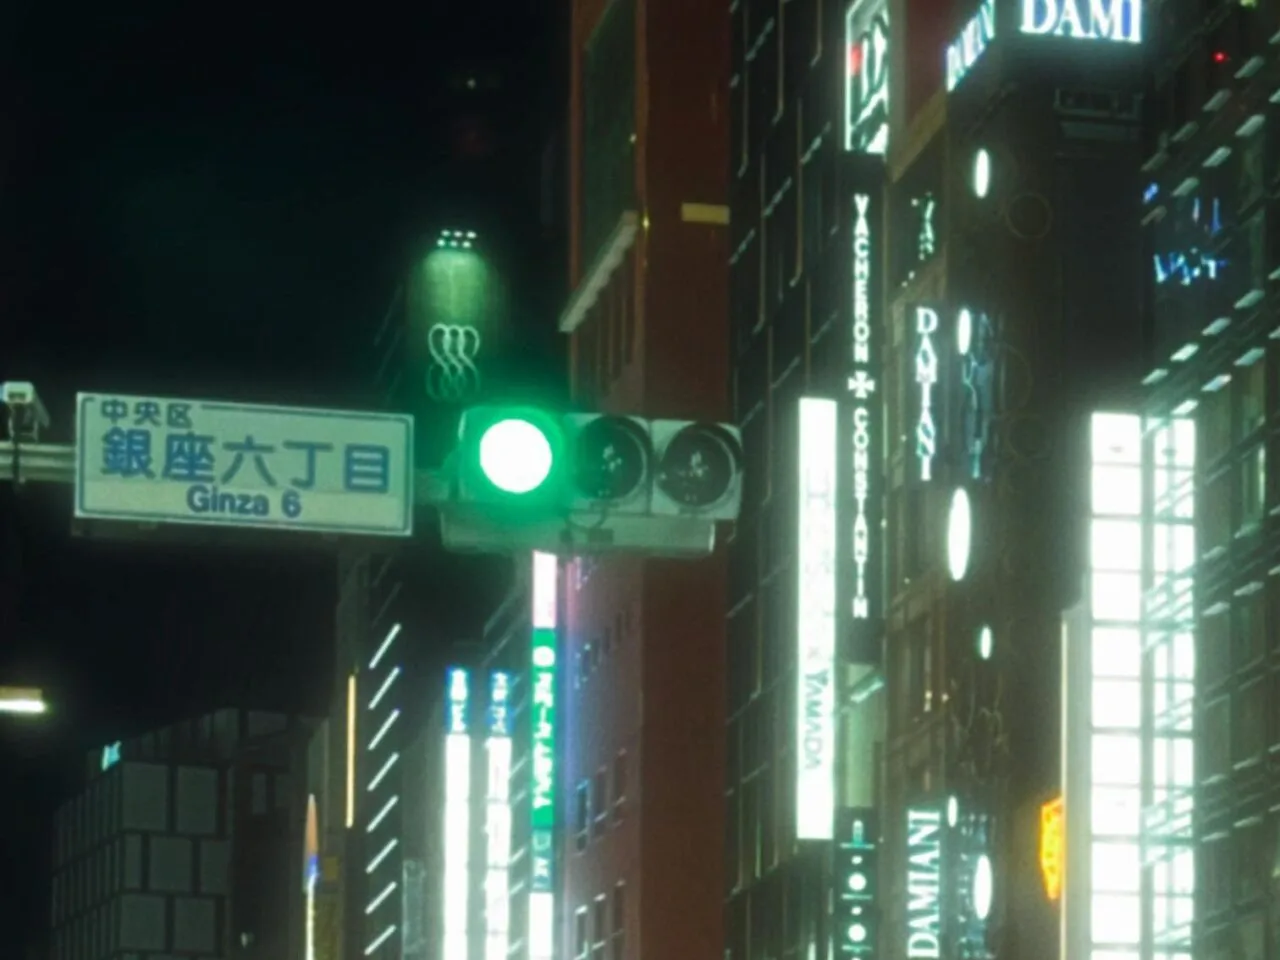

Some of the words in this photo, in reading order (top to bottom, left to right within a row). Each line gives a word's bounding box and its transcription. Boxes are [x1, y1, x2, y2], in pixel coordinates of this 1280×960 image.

[854, 194, 870, 363] VACHERON
[101, 398, 193, 430] 中央区
[915, 306, 938, 481] DAMIANI
[101, 426, 390, 494] 銀座六丁目
[186, 484, 270, 517] Ginza
[281, 489, 302, 519] 6
[853, 407, 869, 619] CONSTANTIN
[803, 668, 829, 770] YAMADA
[907, 810, 941, 959] DAMIANI
